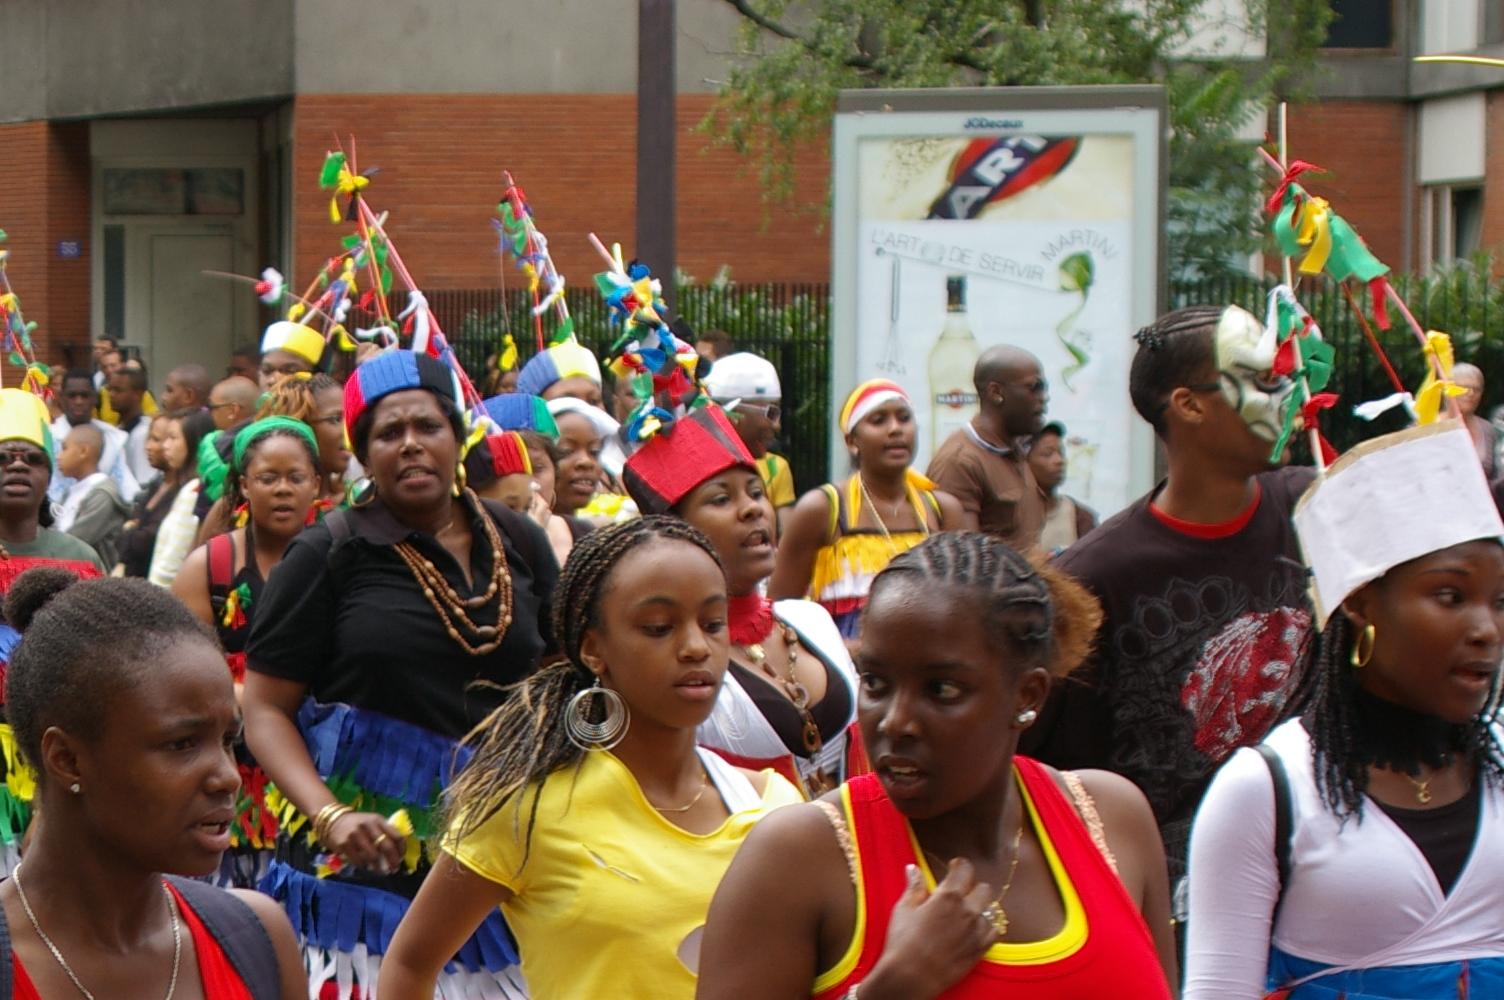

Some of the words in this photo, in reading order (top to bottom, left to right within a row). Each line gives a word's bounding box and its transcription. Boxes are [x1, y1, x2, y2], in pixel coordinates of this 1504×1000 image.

[964, 117, 1024, 129] JCDecaux
[936, 136, 1050, 220] ART
[871, 229, 922, 253] L'ART
[948, 245, 972, 265] DE
[979, 251, 1045, 282] SERVIR
[1041, 229, 1120, 262] MARTINI
[937, 394, 977, 403] MARTINI
